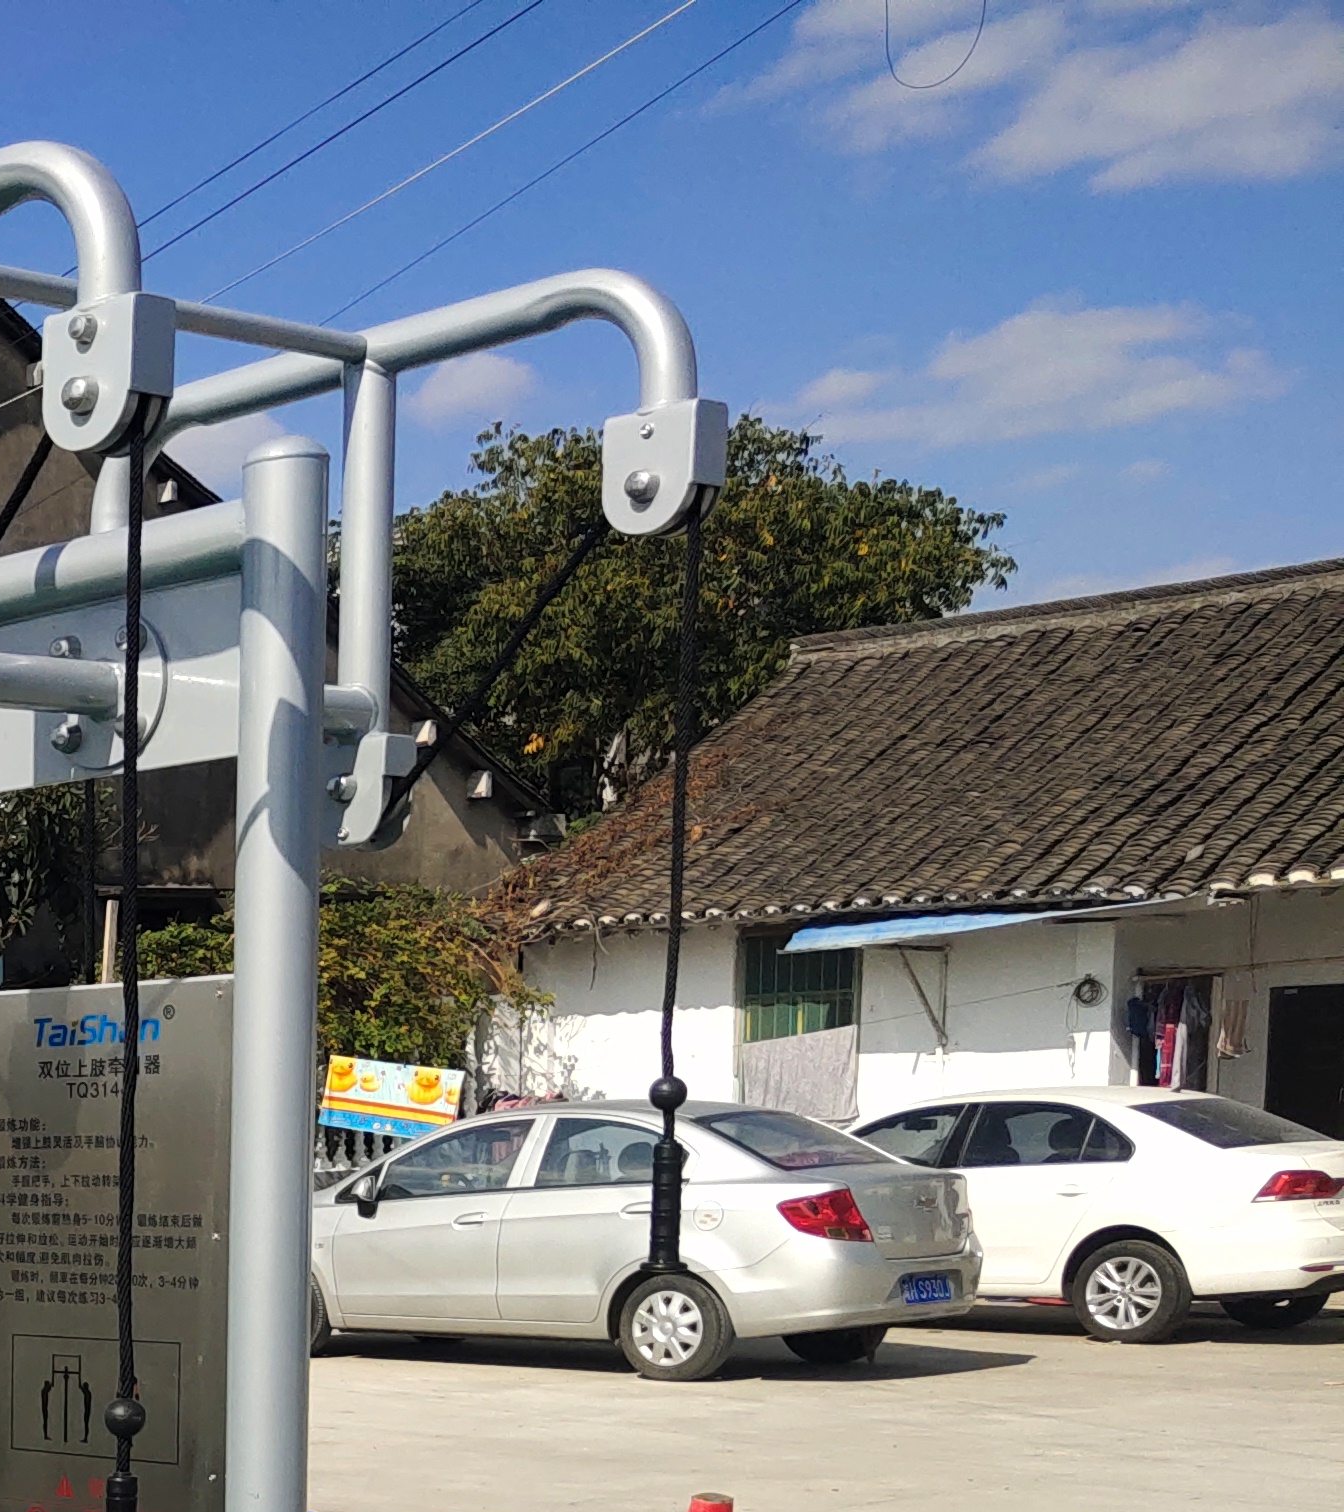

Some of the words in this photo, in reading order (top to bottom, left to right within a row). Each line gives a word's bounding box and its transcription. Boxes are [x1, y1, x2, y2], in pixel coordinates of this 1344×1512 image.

[33, 1015, 160, 1048] TaiShn
[38, 1055, 160, 1079] 双位上肢牵器
[66, 1082, 123, 1098] TQ314
